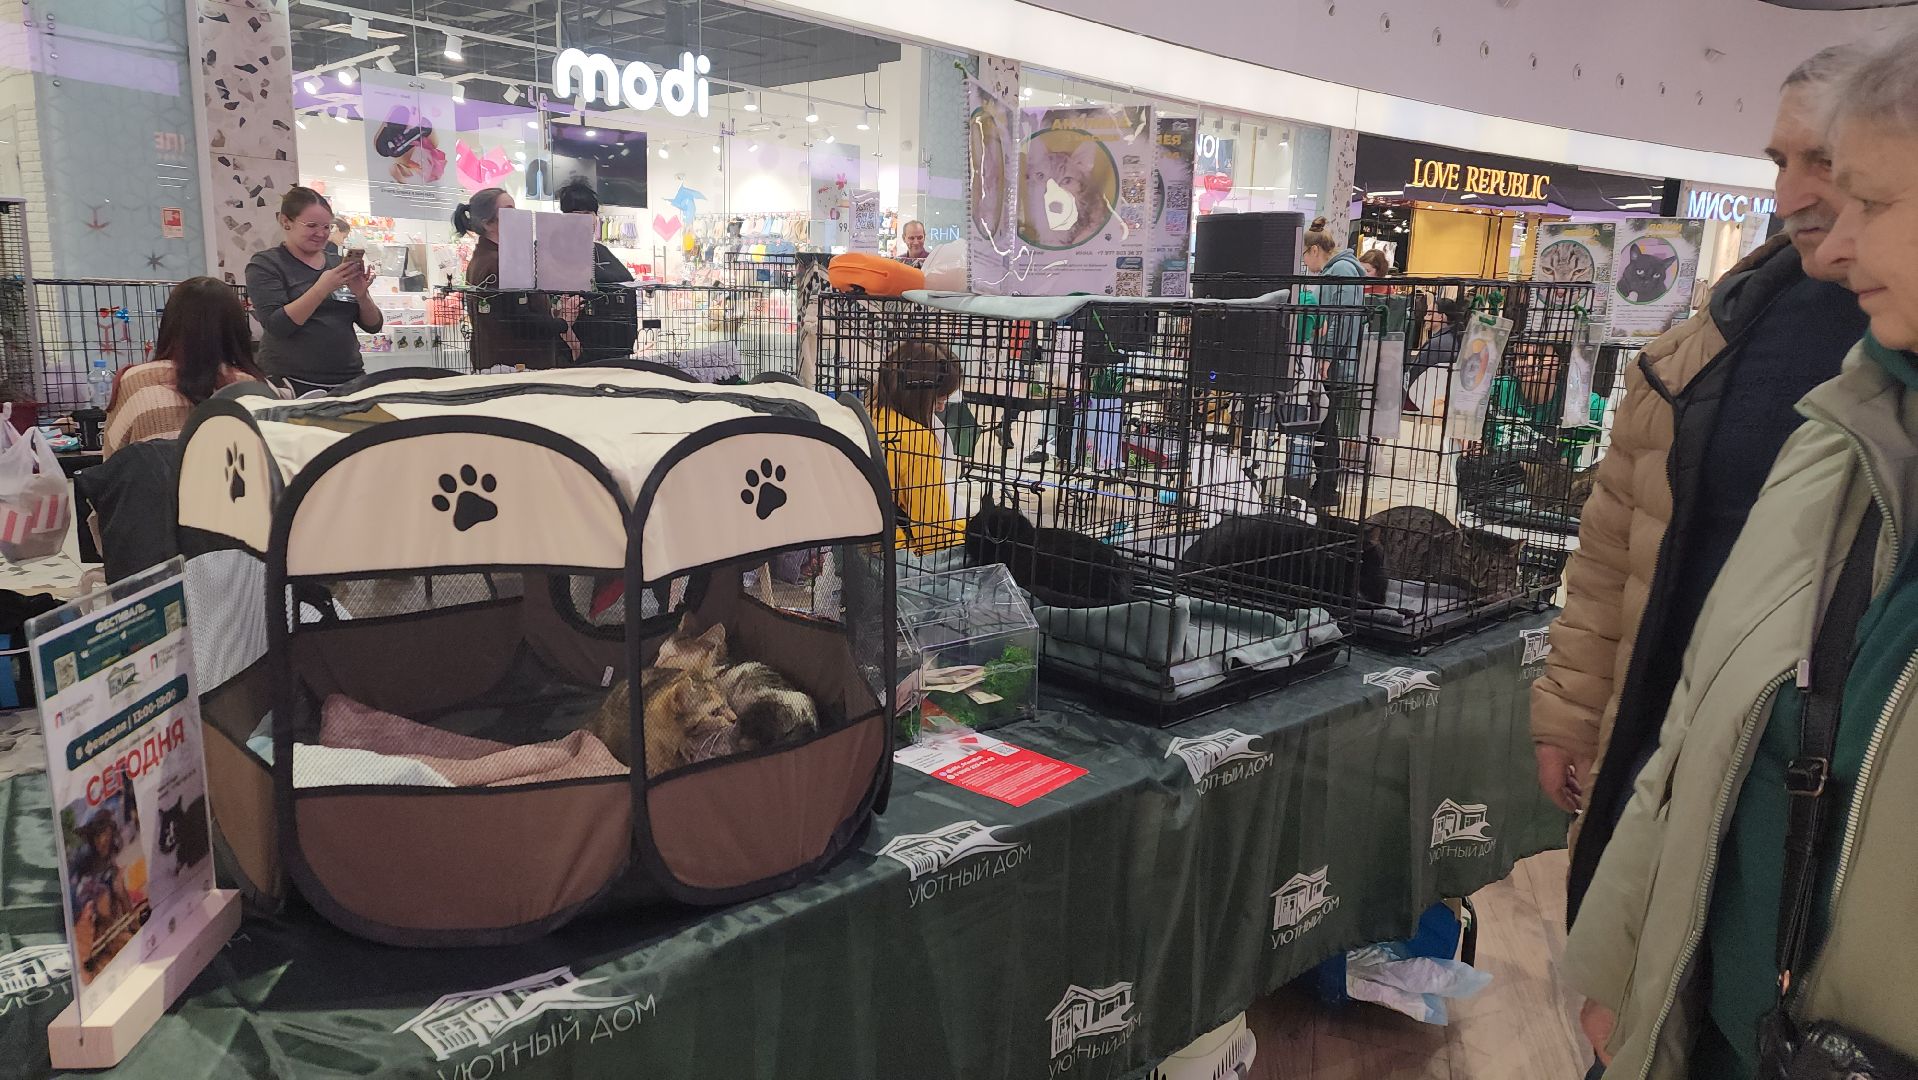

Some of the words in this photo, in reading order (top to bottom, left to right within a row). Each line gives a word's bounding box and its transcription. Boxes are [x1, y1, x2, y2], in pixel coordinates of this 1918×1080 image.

[553, 48, 711, 118] modi
[1412, 158, 1460, 190] LOVE
[1464, 165, 1550, 200] REPUBLIC
[1687, 190, 1749, 222] МИСС
[86, 717, 185, 807] СЕГОДНЯ
[1245, 752, 1274, 780] ДОМ
[908, 856, 990, 909] УЮТНЫЙ
[992, 843, 1032, 879] ДОМ
[436, 1015, 581, 1080] УЮТНЫЙ
[589, 993, 656, 1045] ДОМ
[1048, 1035, 1118, 1080] УЮТНЫЙ
